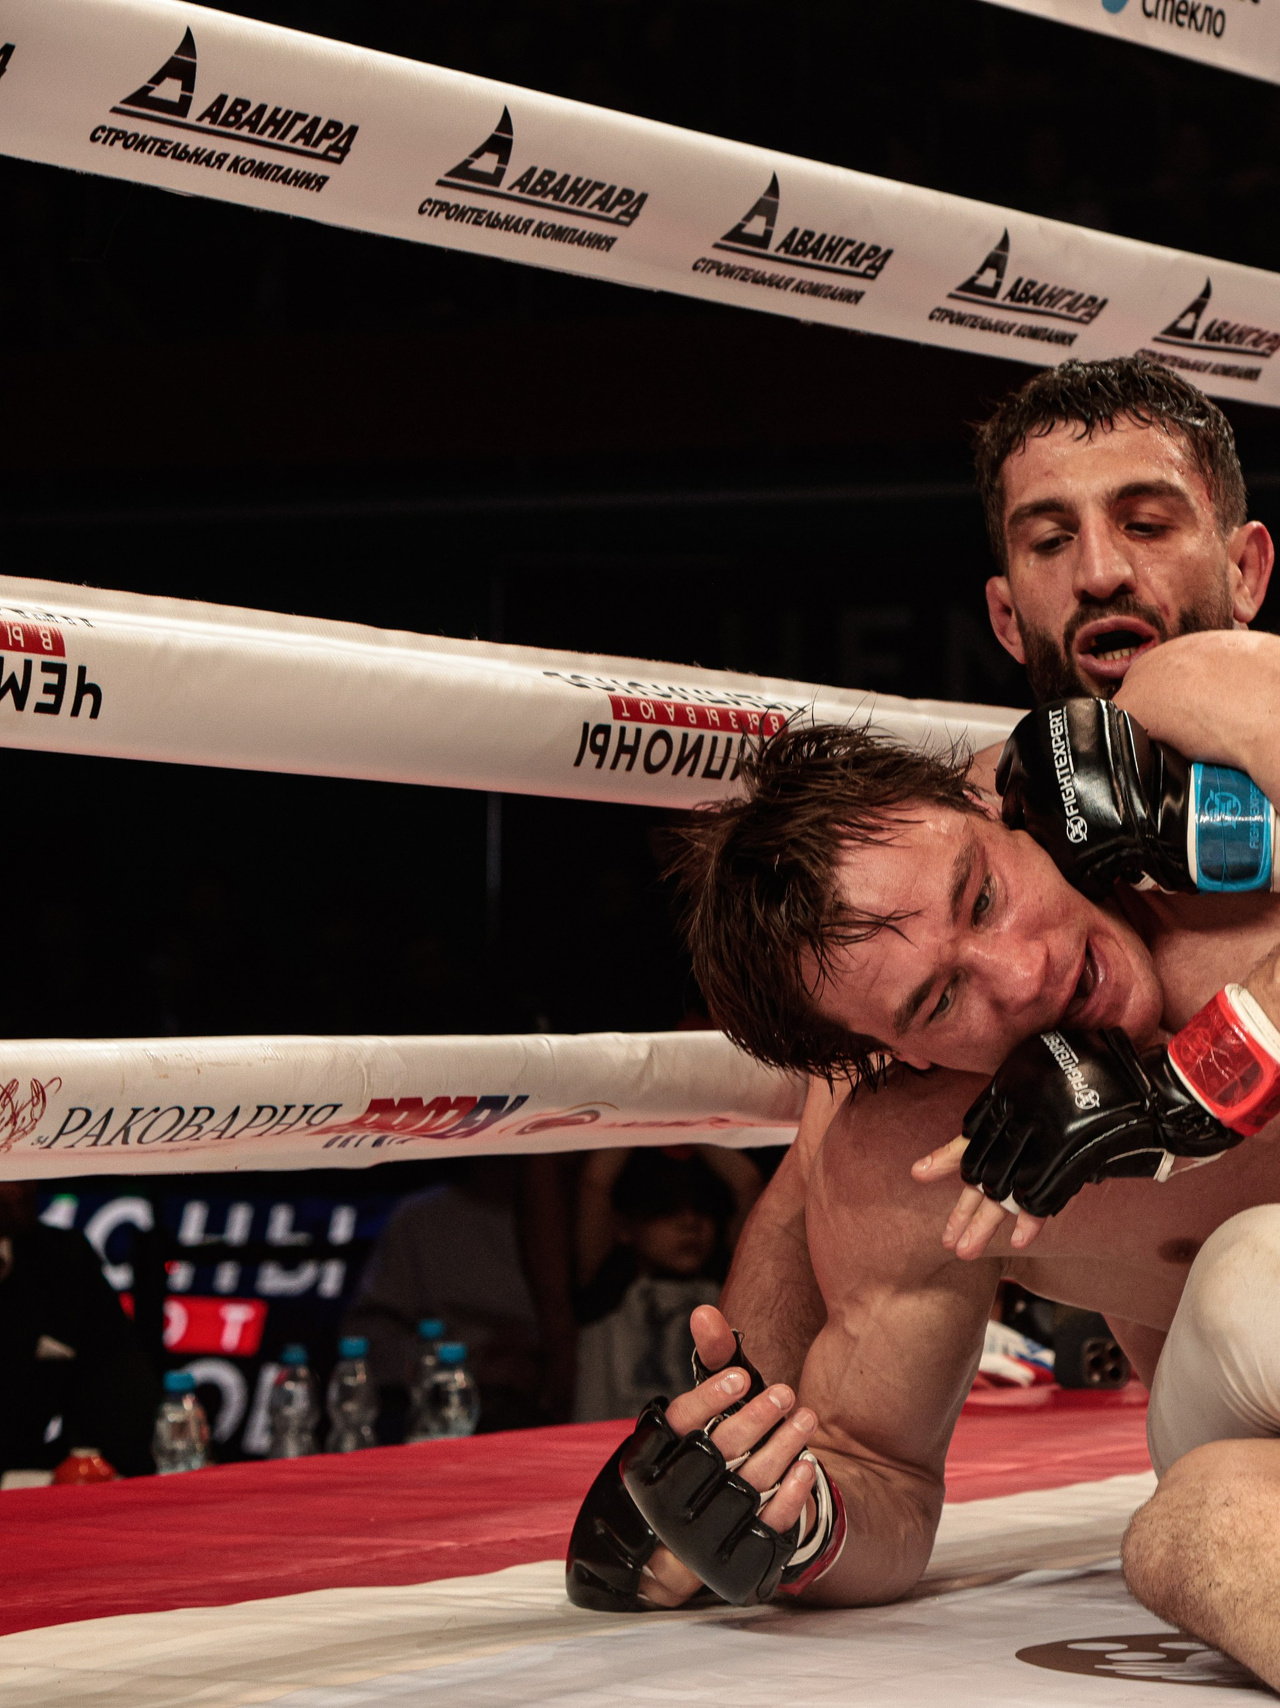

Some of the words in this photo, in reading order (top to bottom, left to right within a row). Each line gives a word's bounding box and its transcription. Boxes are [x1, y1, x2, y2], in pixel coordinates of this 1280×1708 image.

[196, 94, 360, 157] АВАНГАРД
[89, 125, 227, 172] СТРОИТЕЛЬНАЯ
[226, 154, 330, 193] КОМПАНИЯ
[507, 166, 650, 221] АВАНГАРД
[418, 199, 534, 238] СТРОИТЕЛЬНАЯ
[533, 217, 618, 253] КОМПАНИЯ
[775, 226, 894, 277] АВАНГАРД
[692, 258, 794, 295] СТРОИТЕЛЬНАЯ
[790, 276, 867, 306] КОМПАНИЯ
[1003, 275, 1109, 322] АВАНГАРД
[620, 698, 781, 733] ВЫЗЫВАЮТ
[573, 721, 748, 782] ПИОНЫ
[1048, 709, 1079, 818] FIGHTEXPERT
